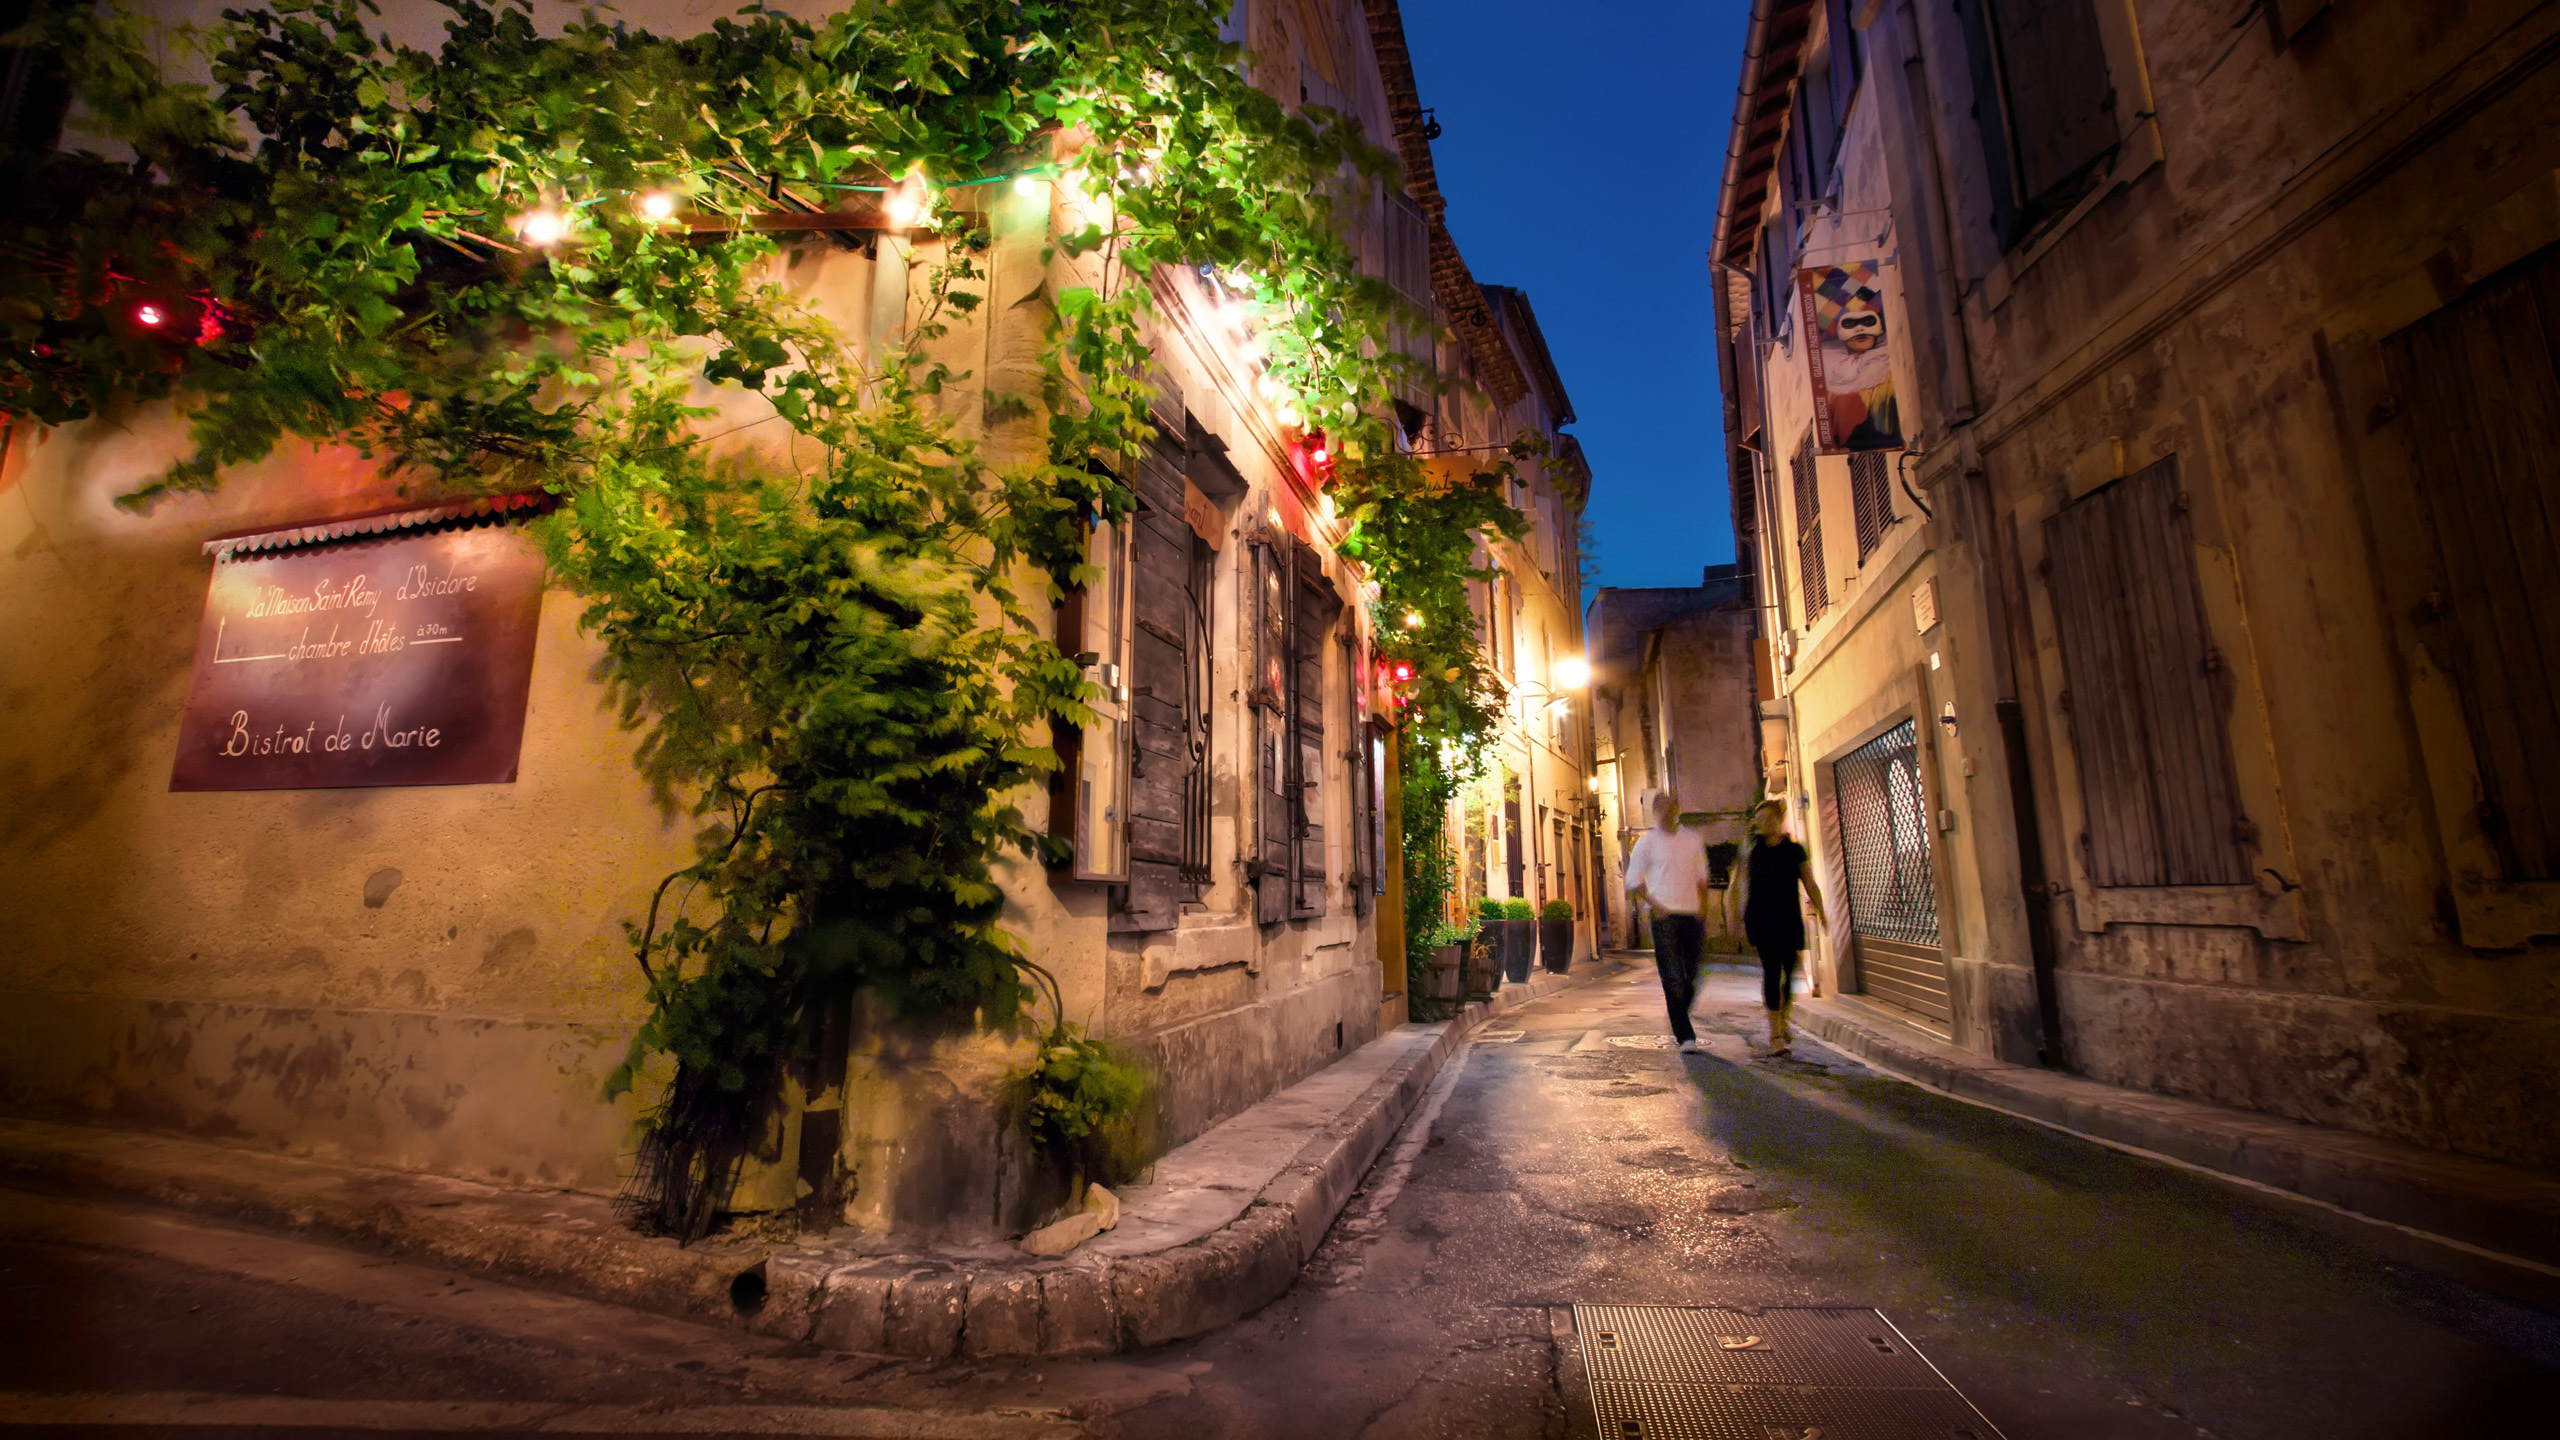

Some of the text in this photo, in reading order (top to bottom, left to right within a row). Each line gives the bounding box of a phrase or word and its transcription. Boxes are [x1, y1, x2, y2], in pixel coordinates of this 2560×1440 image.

[1804, 293, 1814, 322] PASSION
[1808, 324, 1818, 349] PASTEL
[1811, 348, 1822, 378] GALERIE
[1816, 397, 1829, 420] RISCH
[396, 562, 477, 600] d'Isidore
[288, 618, 406, 660] chambre d'hôtes
[218, 699, 441, 757] Bistrot de Marie
